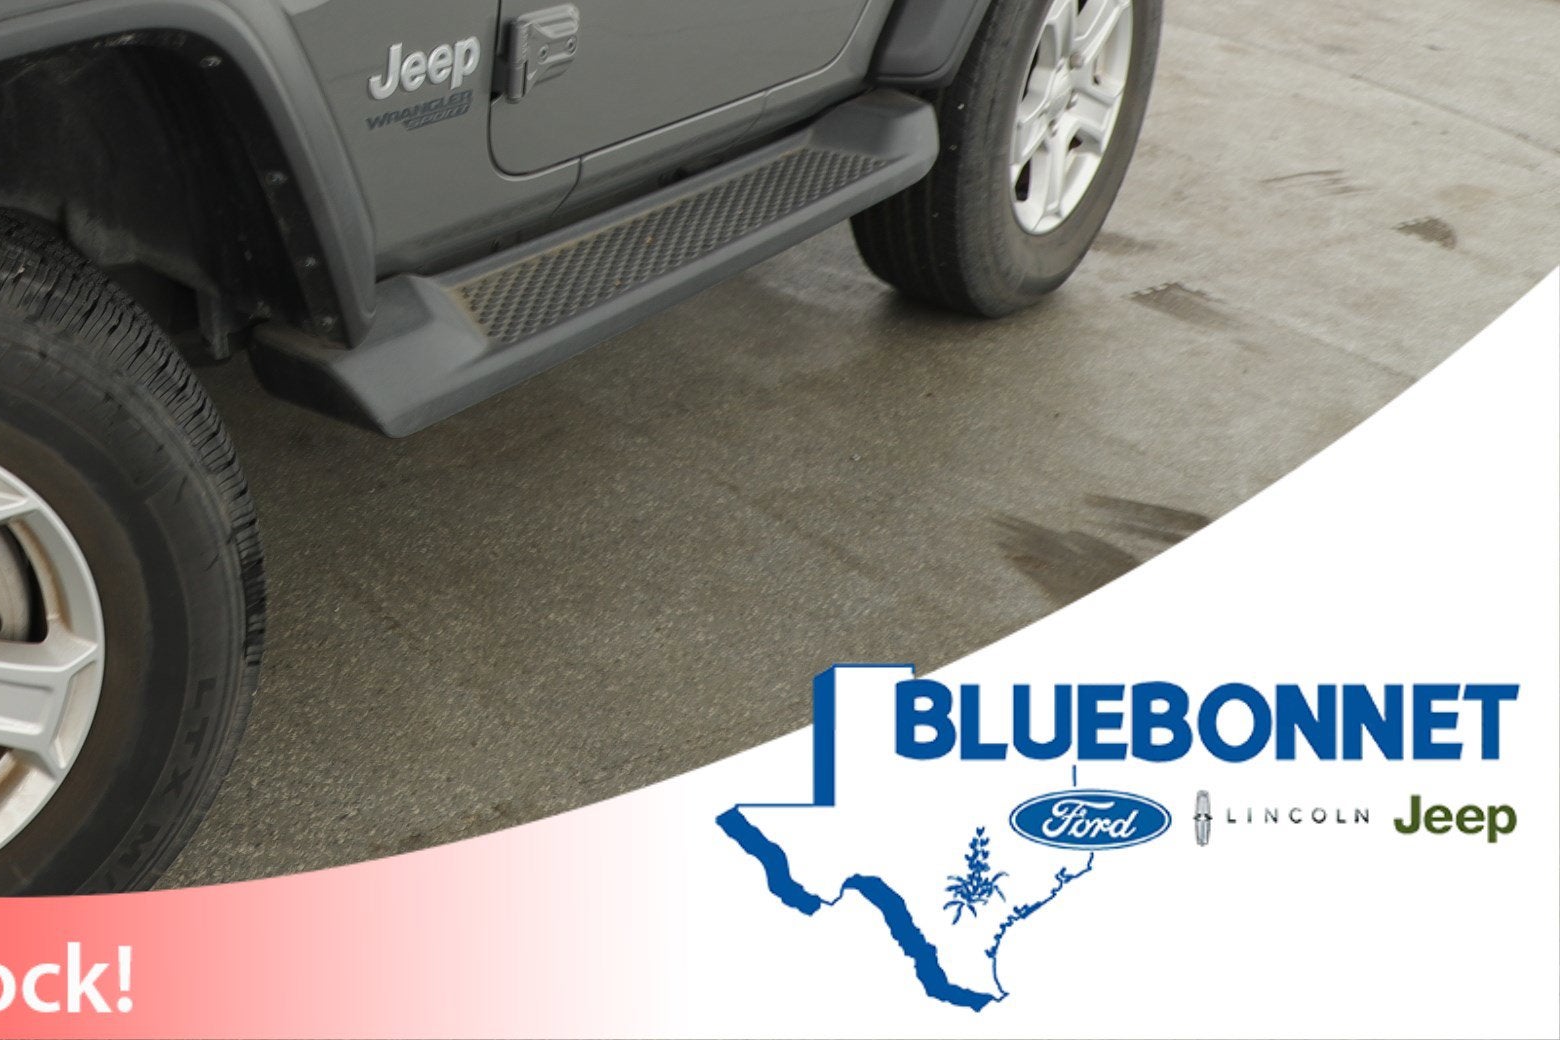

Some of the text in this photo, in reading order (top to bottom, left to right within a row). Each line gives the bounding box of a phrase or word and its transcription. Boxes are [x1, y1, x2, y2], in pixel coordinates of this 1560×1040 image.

[367, 36, 480, 101] Jeep
[366, 90, 474, 131] WRANGLER
[159, 676, 217, 798] LTX
